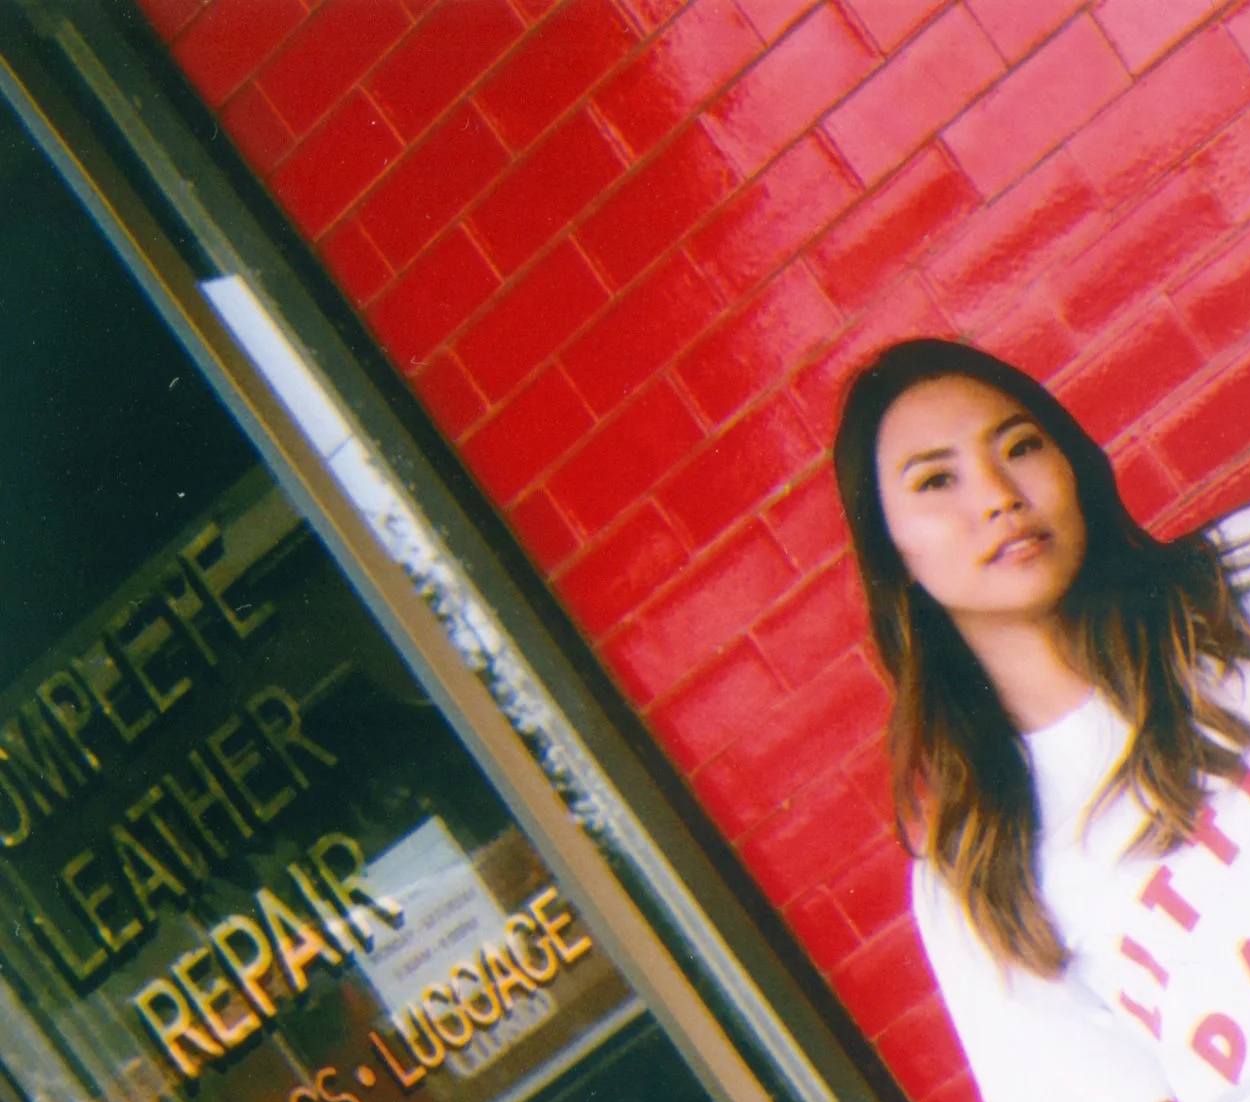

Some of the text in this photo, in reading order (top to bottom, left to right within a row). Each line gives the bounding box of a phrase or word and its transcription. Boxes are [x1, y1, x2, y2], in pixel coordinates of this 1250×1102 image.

[33, 685, 338, 981] LEATHER
[134, 832, 402, 1077] REPAIR
[369, 886, 593, 1087] LUGGAGE
